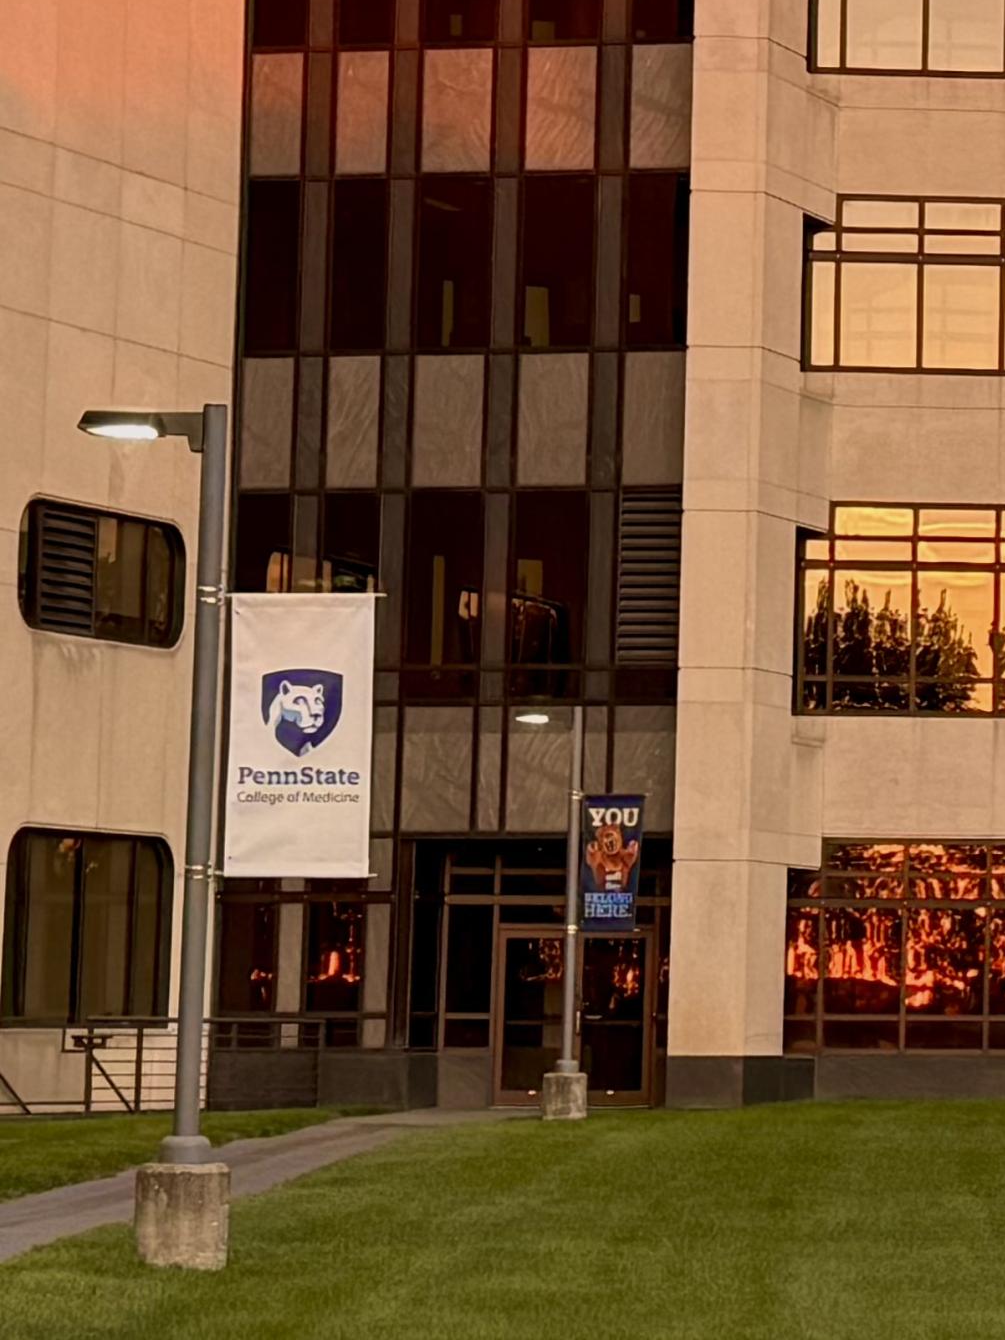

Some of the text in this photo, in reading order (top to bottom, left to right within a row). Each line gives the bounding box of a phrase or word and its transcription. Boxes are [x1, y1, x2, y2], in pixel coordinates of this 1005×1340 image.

[236, 791, 360, 805] College of Medicine
[589, 807, 640, 827] YOU
